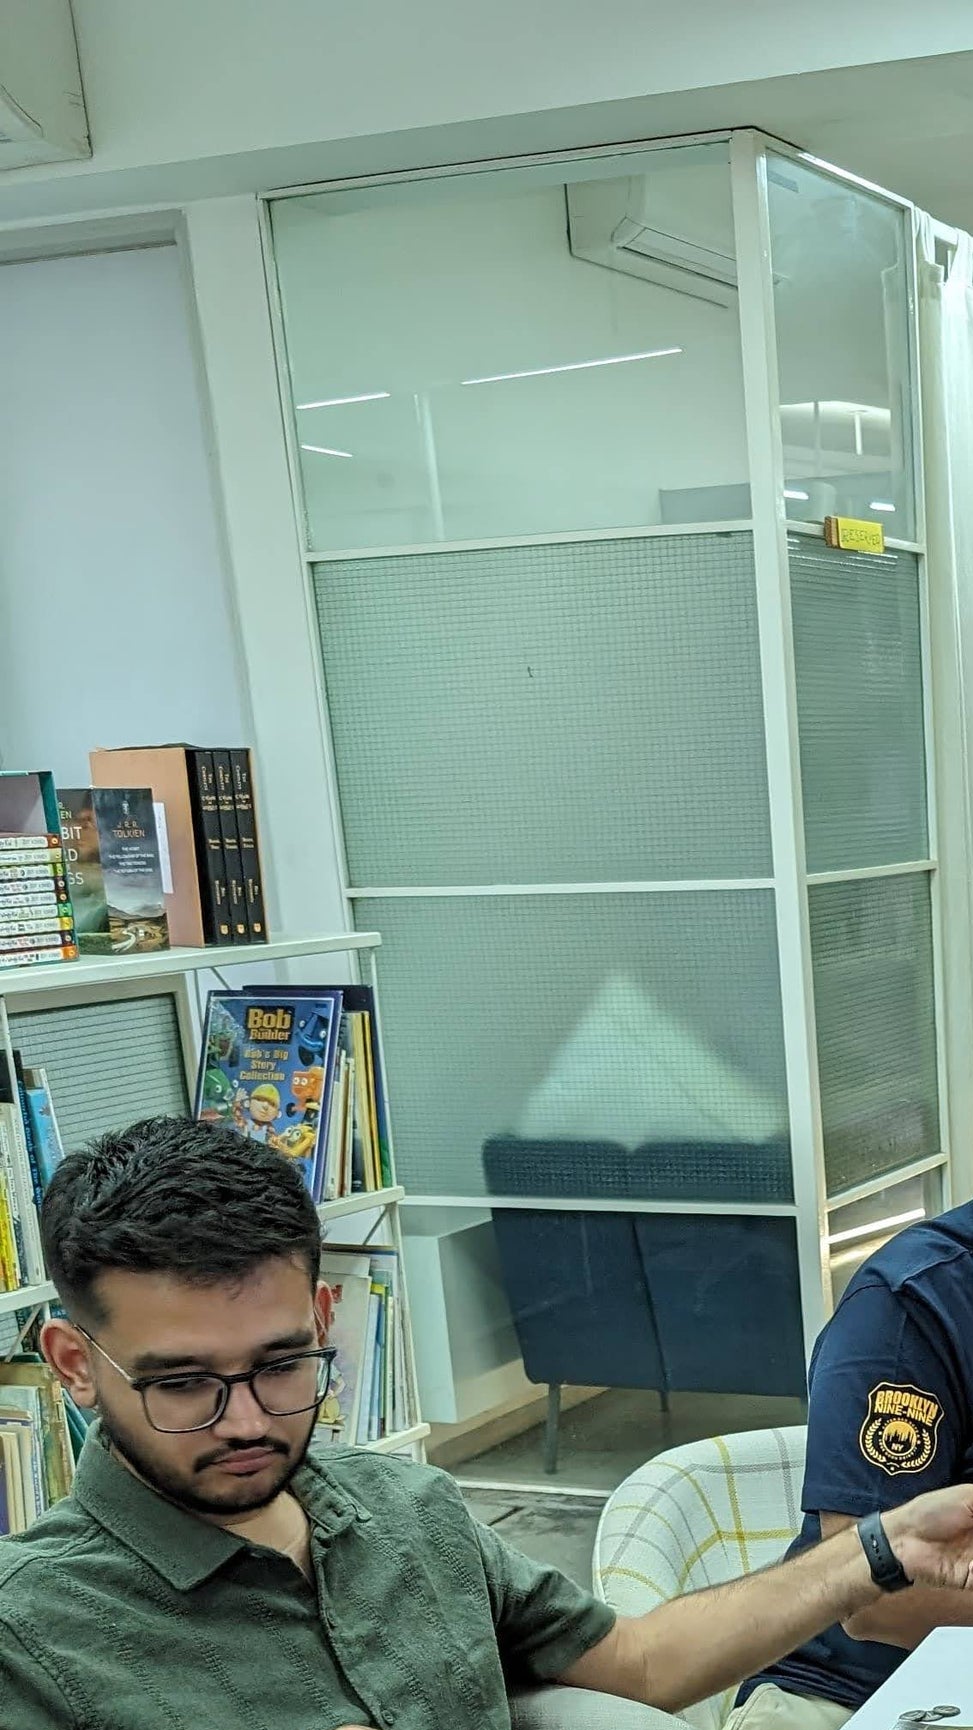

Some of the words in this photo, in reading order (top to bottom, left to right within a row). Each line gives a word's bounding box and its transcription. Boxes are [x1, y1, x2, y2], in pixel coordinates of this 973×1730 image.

[112, 829, 145, 839] TOLKIEN
[247, 1008, 291, 1030] Bob
[249, 1028, 291, 1041] Builder
[251, 1060, 277, 1071] Story
[240, 1070, 285, 1081] Collection
[875, 1389, 939, 1420] BROOKLYN
[873, 1400, 933, 1427] NINE-NINE
[890, 1442, 905, 1452] NY
